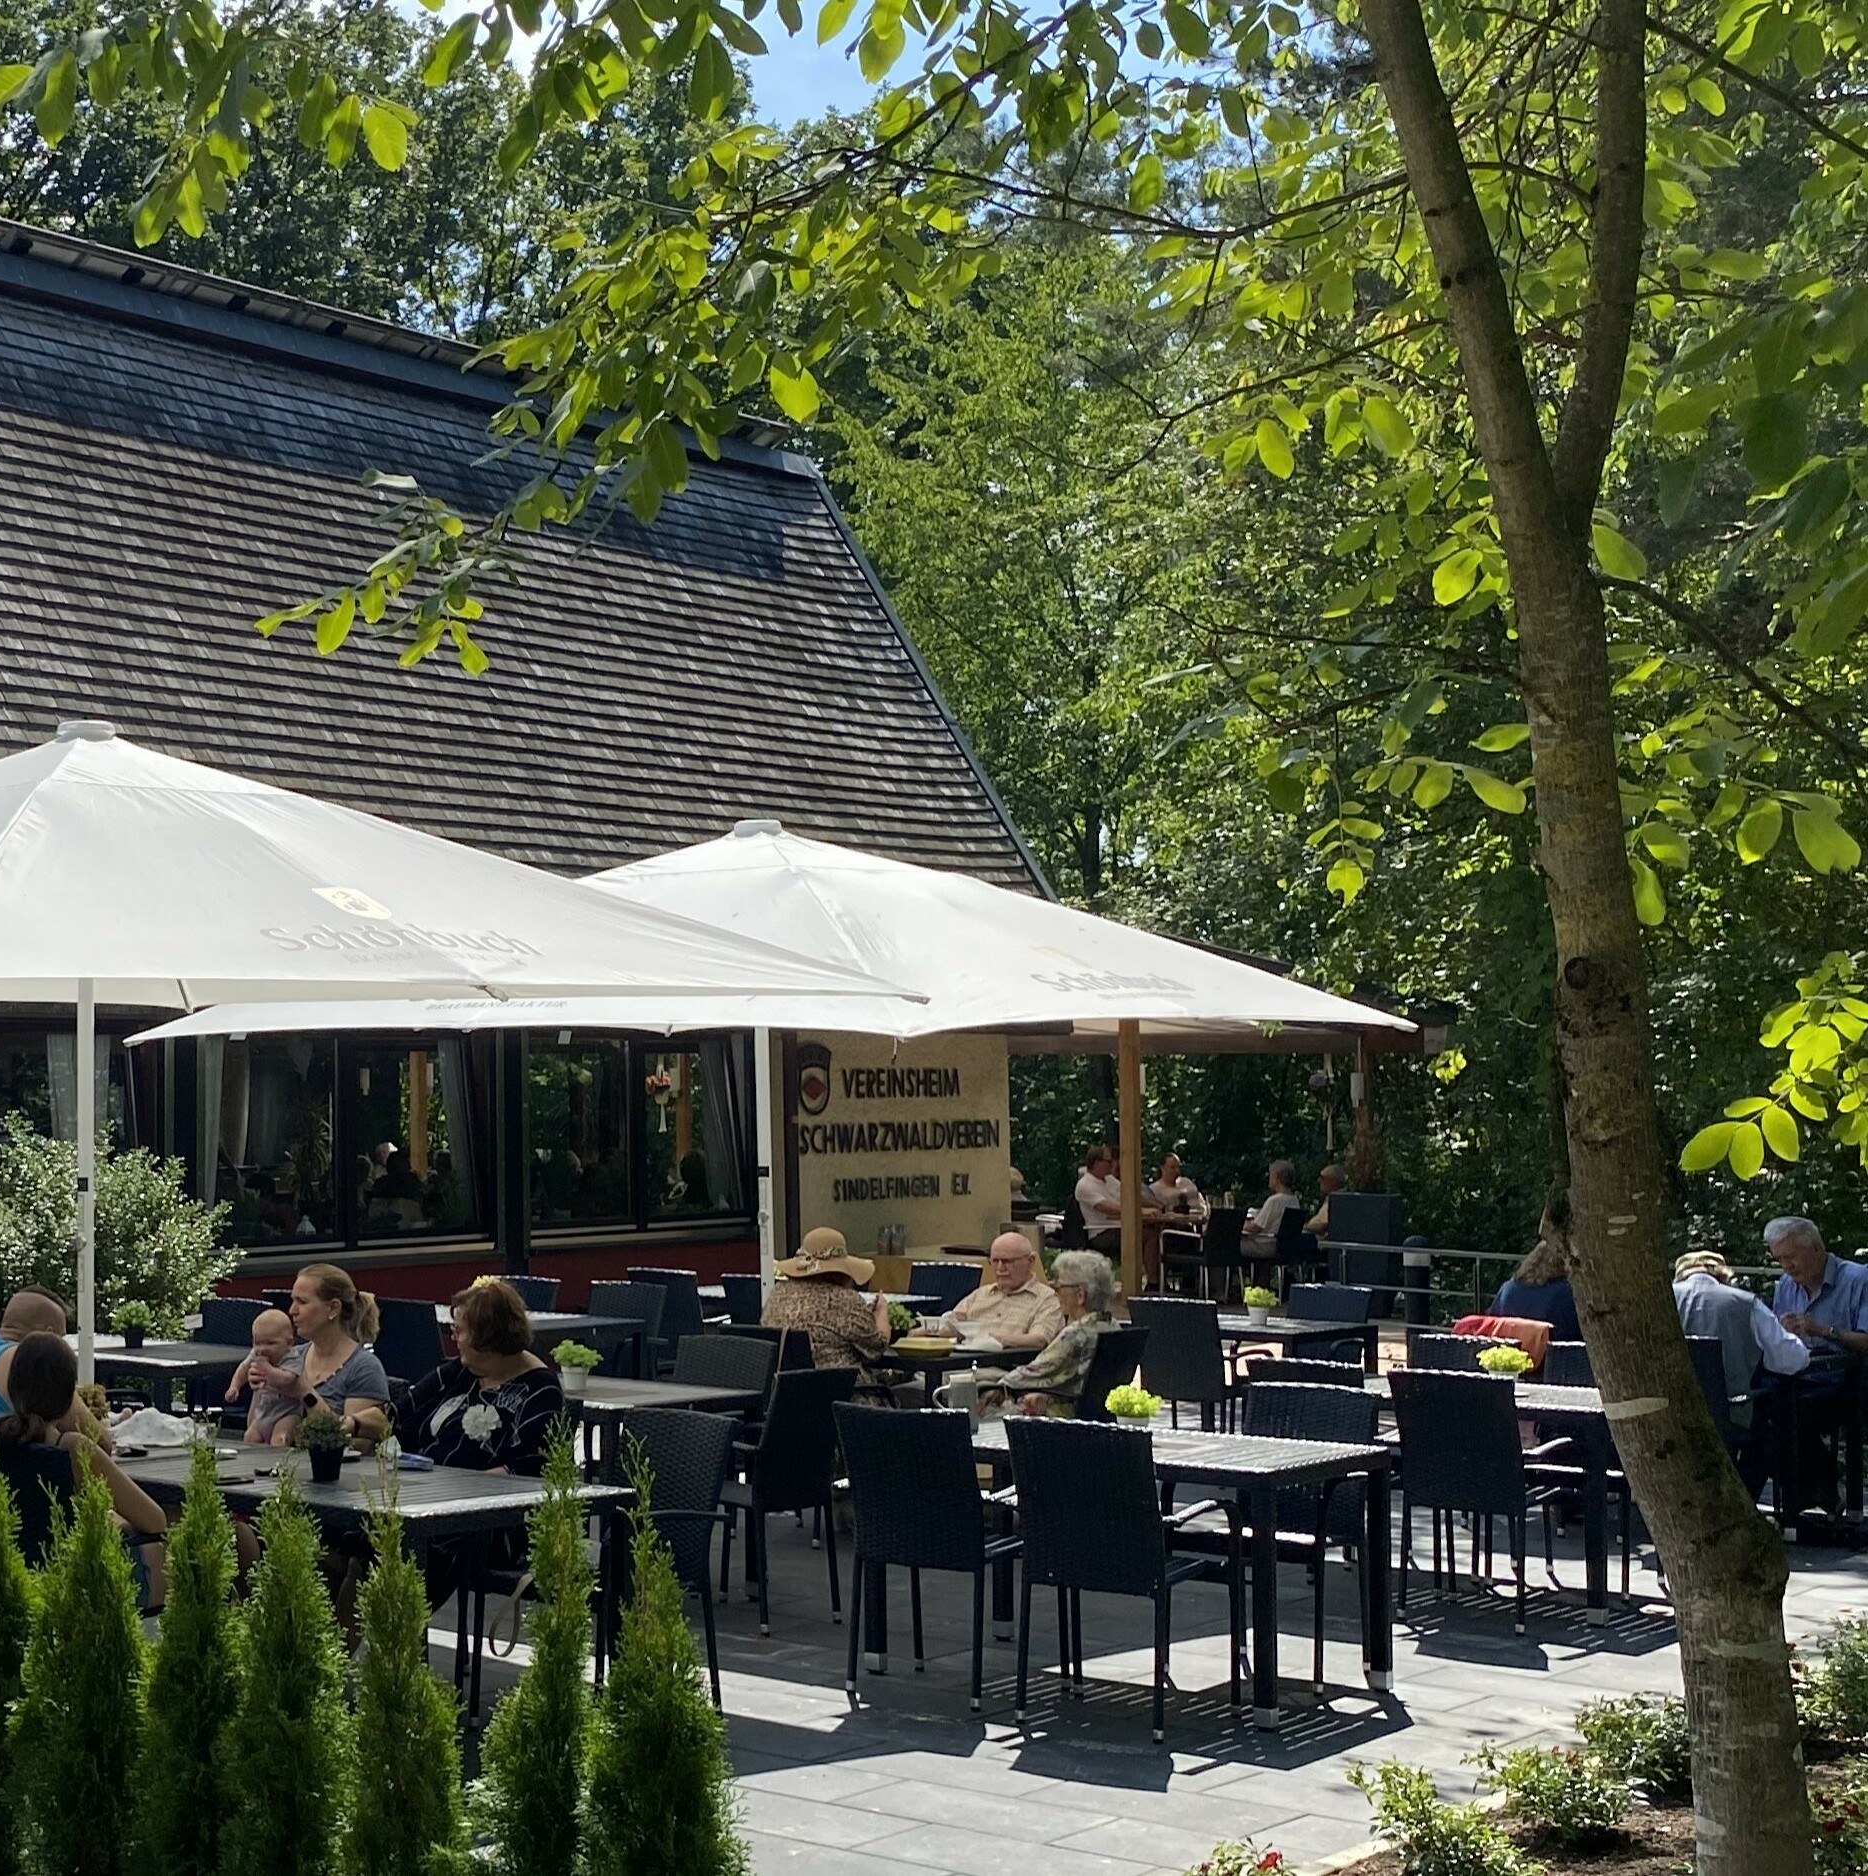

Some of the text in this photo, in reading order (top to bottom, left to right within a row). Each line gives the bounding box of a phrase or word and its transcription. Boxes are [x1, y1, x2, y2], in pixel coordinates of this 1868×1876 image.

[259, 922, 544, 956] Schönbuch
[841, 1065, 961, 1099] VEREINSHEIM
[799, 1118, 1000, 1155] SCHWARZWALDVEREIN
[833, 1174, 940, 1202] SINDELFINGEN
